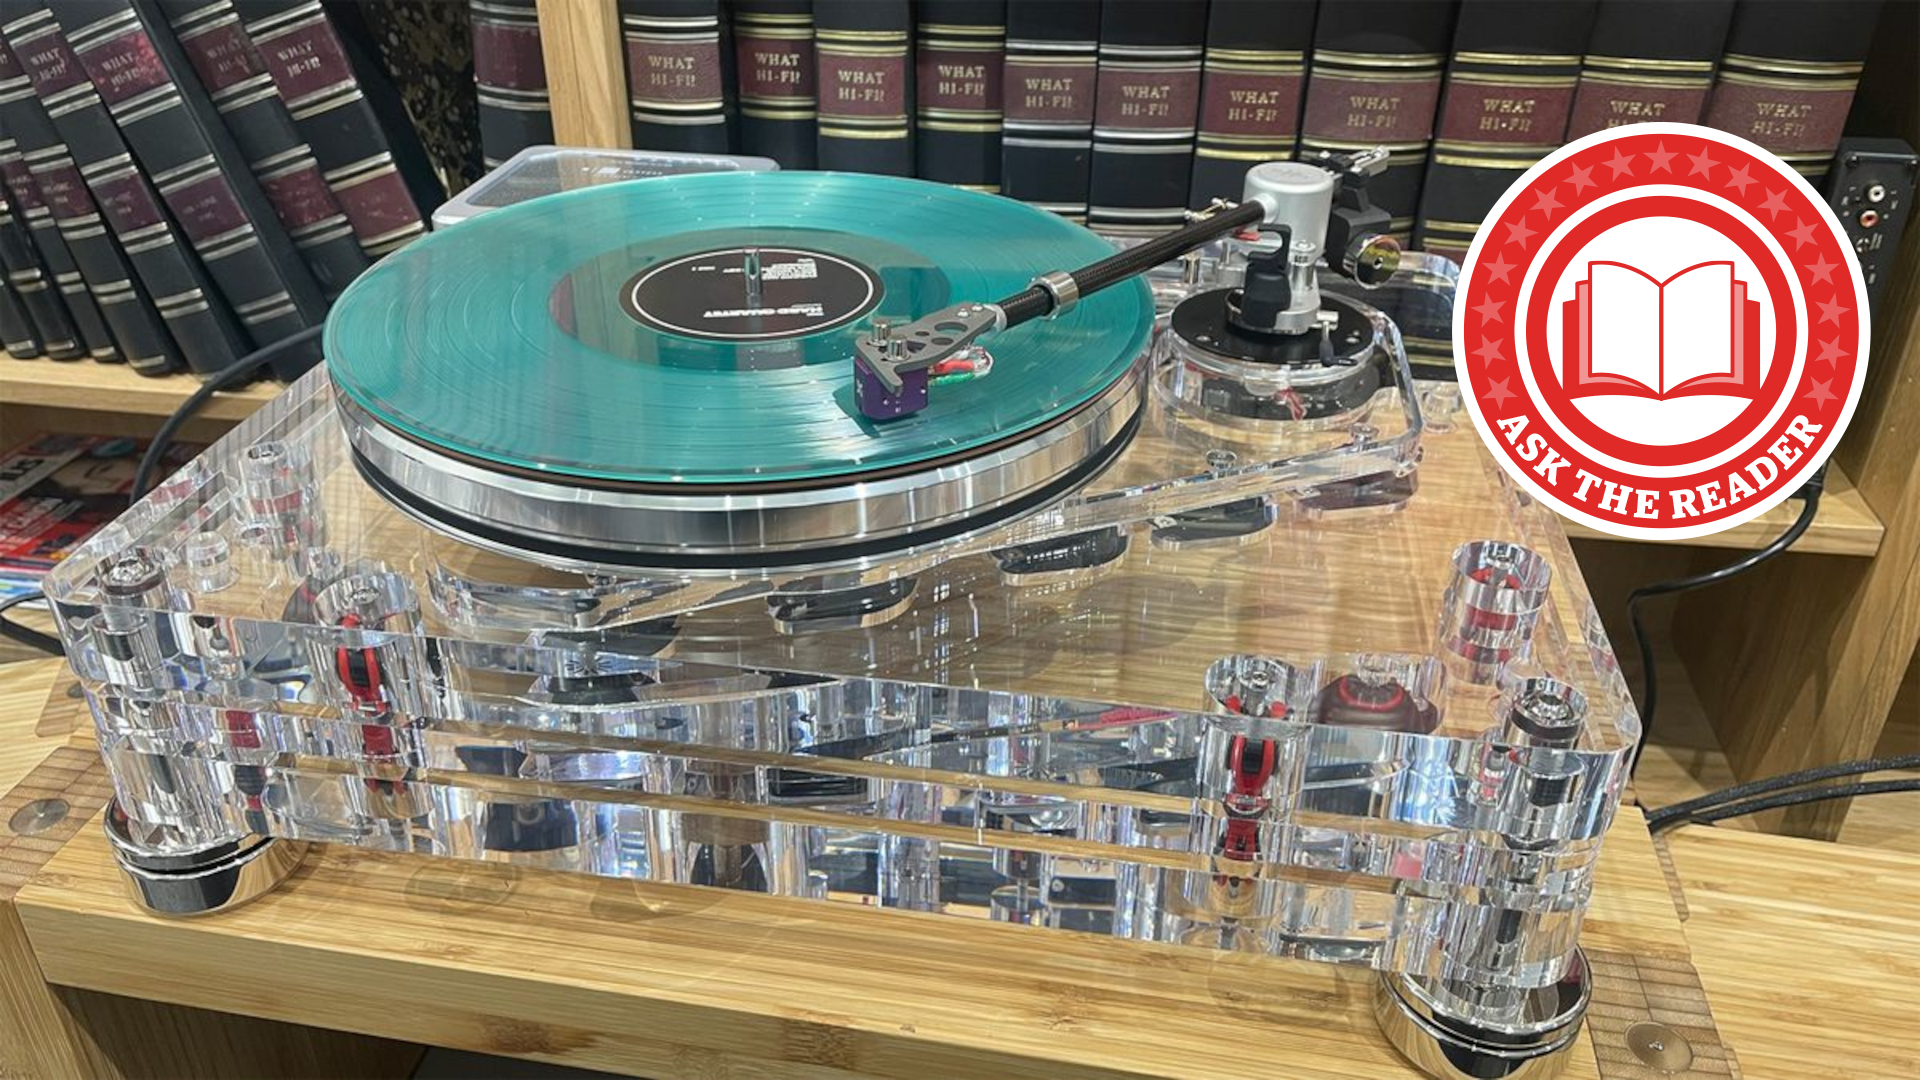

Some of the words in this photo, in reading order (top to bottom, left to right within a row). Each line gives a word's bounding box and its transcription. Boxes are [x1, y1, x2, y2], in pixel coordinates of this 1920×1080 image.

[648, 55, 695, 69] WHAT
[755, 52, 800, 66] WHAT
[838, 69, 885, 84] WHAT
[938, 64, 985, 78] WHAT
[1025, 78, 1073, 91] WHAT
[1122, 85, 1170, 99] WHAT
[1229, 90, 1280, 104] WHAT
[1349, 95, 1400, 110] WHAT
[1484, 99, 1535, 113] WHAT
[1611, 101, 1665, 116] WHAT
[1757, 103, 1812, 118] WHAT
